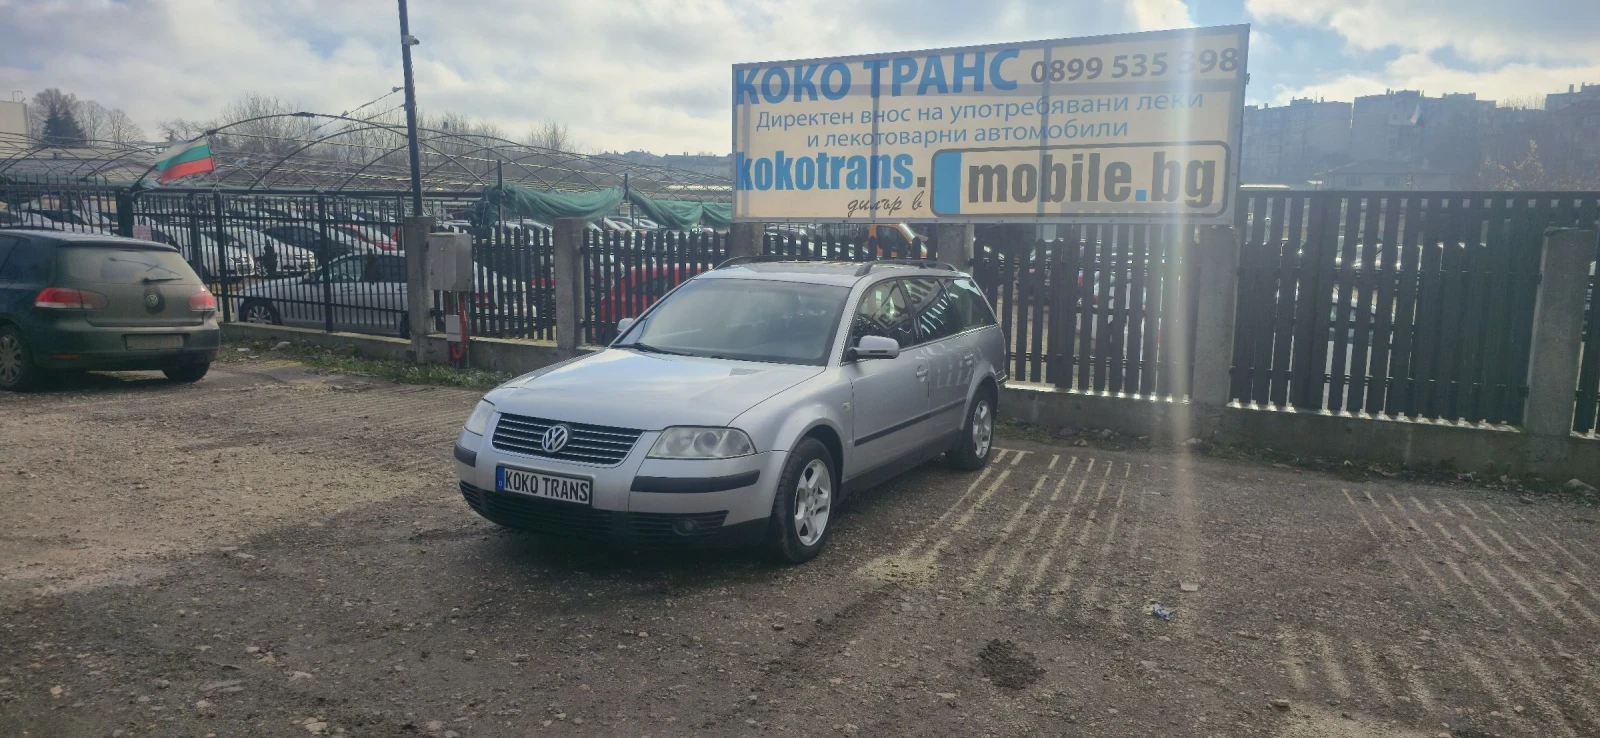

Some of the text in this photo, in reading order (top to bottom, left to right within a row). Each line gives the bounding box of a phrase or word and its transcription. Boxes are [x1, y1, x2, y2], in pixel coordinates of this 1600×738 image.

[736, 48, 1020, 105] КОКО ТРАНС
[1031, 57, 1103, 83] 0899
[1111, 52, 1168, 78] 535
[756, 93, 1203, 131] Директен внос на употребявани леки
[807, 119, 1128, 148] и лекотоварни автомобили
[969, 152, 1215, 208] mobile.bg
[847, 196, 902, 217] дилър
[505, 470, 588, 502] KOKO TRANS
